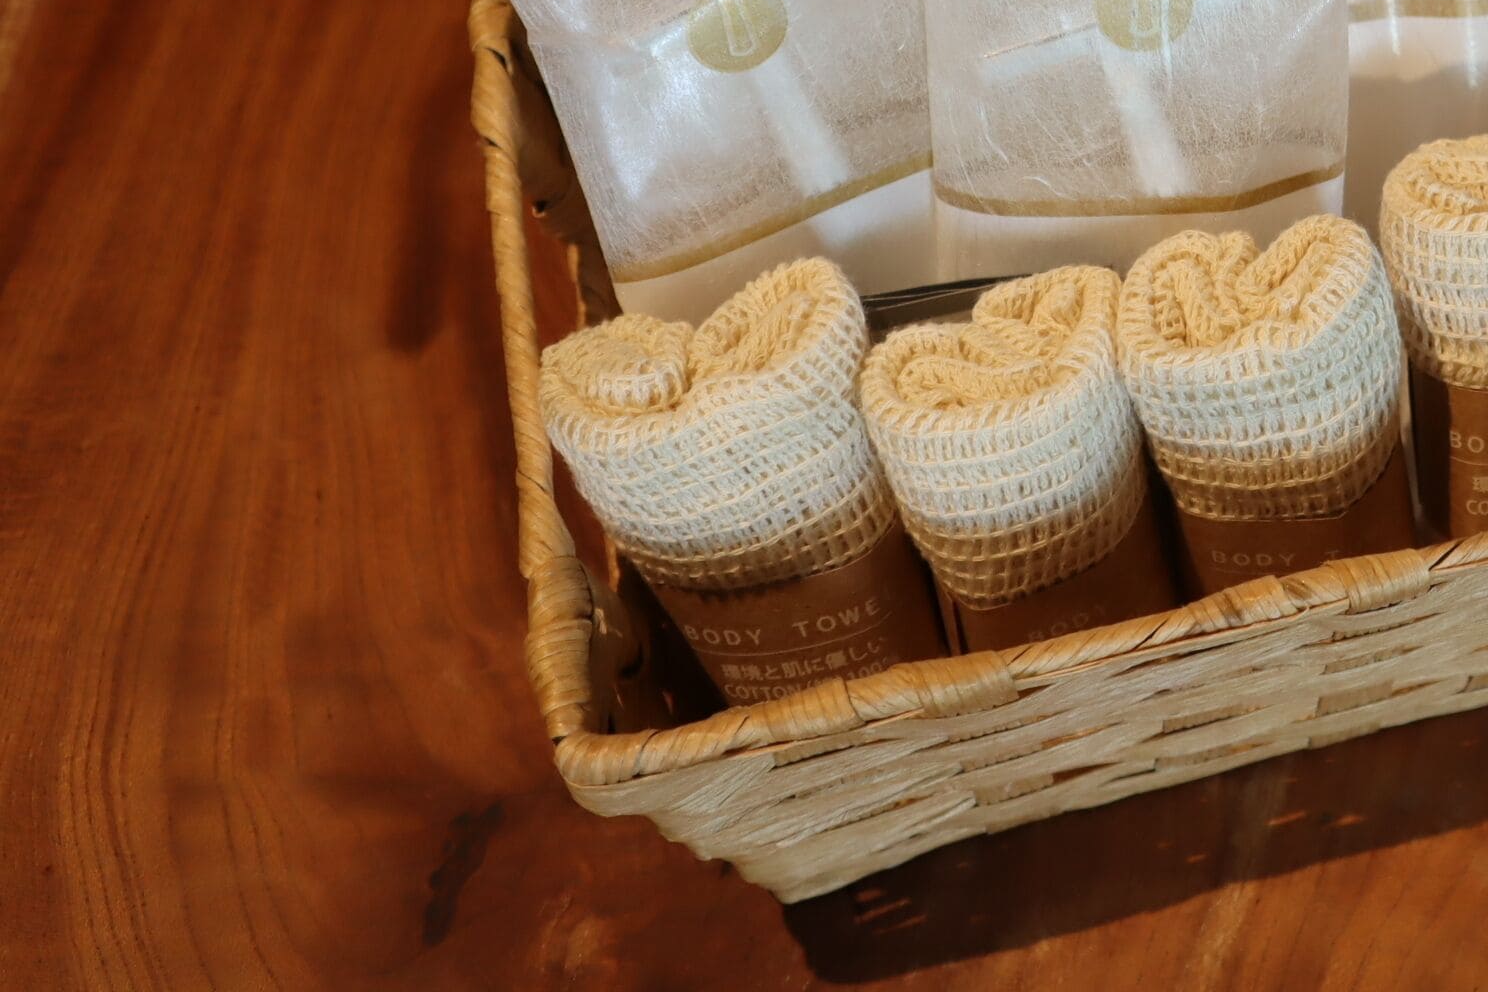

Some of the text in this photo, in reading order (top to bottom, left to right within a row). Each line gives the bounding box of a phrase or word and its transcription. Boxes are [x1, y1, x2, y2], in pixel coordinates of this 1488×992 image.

[1211, 549, 1297, 567] BODY
[682, 596, 882, 646] BODY TOWE
